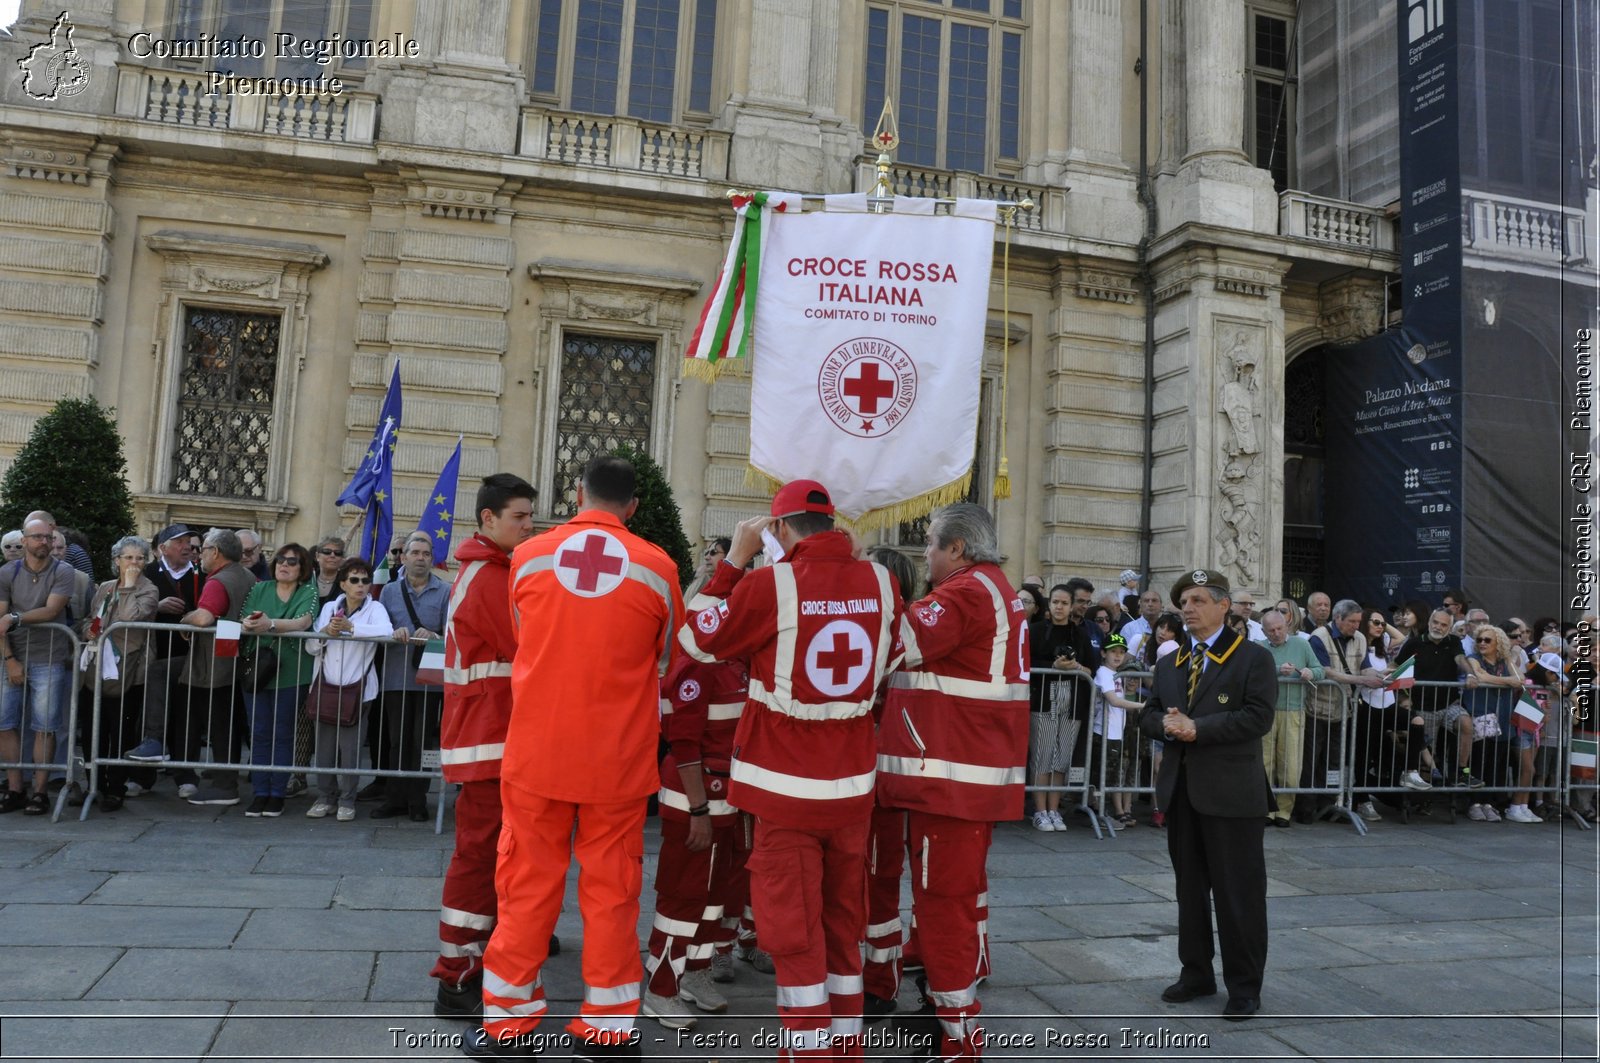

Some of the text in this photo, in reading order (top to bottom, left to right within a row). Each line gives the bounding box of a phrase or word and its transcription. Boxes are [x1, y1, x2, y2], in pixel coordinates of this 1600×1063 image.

[1409, 33, 1444, 57] Fondazione
[1409, 52, 1423, 65] CRT
[1423, 178, 1447, 194] REGIONE
[1423, 243, 1448, 256] Fondazione
[1423, 254, 1433, 263] CRT
[787, 256, 958, 283] CROCE ROSSA
[819, 283, 923, 307] ITALIANA
[804, 308, 937, 326] COMITATO DI TORINO
[822, 342, 914, 427] CONVENZIONE DI GINEVRA 22 AGOSTO 1864
[1365, 377, 1450, 404] Palazzo Madama
[1355, 411, 1377, 421] Museo
[1379, 405, 1400, 417] Civico
[1401, 400, 1425, 413] d'Arte
[1383, 417, 1422, 431] Rinascimento
[1430, 529, 1450, 538] Pinto
[801, 598, 879, 615] CROCE ROSSA ITALIANA
[1111, 634, 1124, 643] NY
